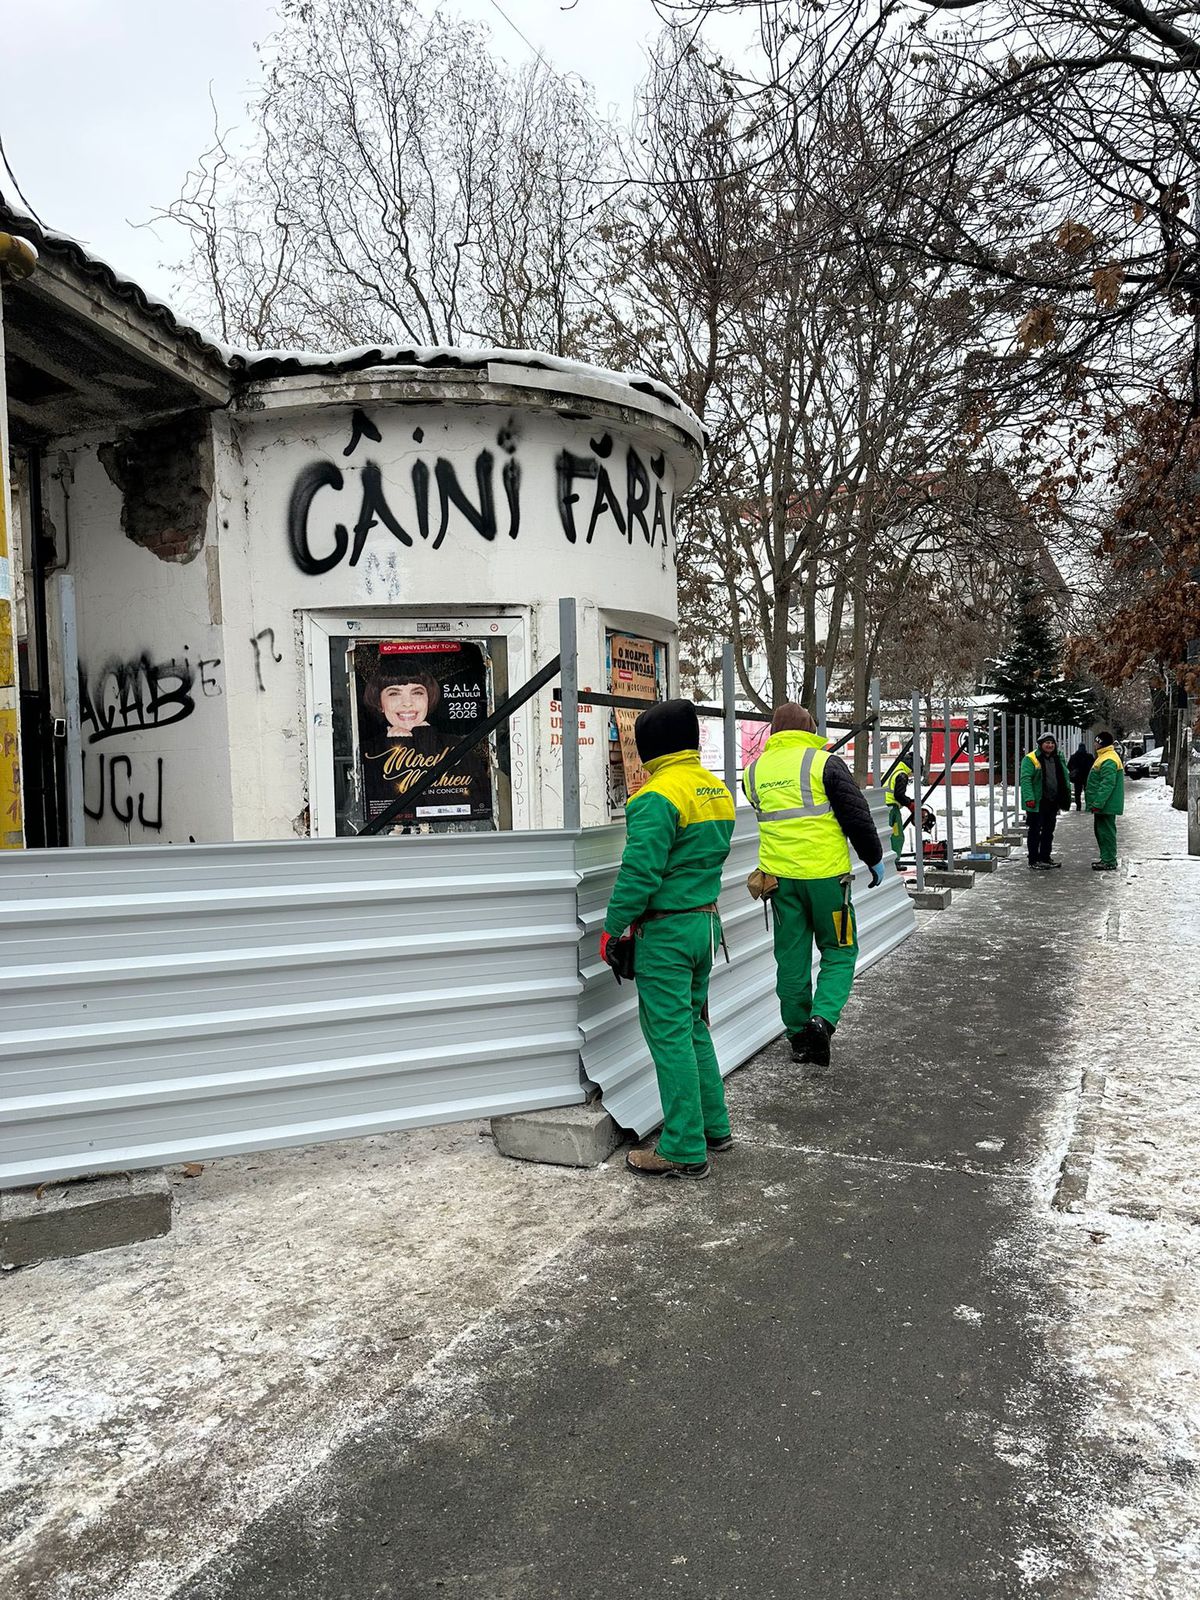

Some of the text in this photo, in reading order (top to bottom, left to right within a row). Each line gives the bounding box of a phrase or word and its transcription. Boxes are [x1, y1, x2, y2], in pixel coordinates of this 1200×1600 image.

[556, 432, 668, 548] FĂRĂ
[618, 647, 650, 663] O NOAPTE
[443, 683, 480, 692] SALA
[448, 702, 477, 711] 22.02
[448, 710, 477, 719] 2026
[428, 787, 436, 795] IN
[436, 787, 469, 795] CONCERT
